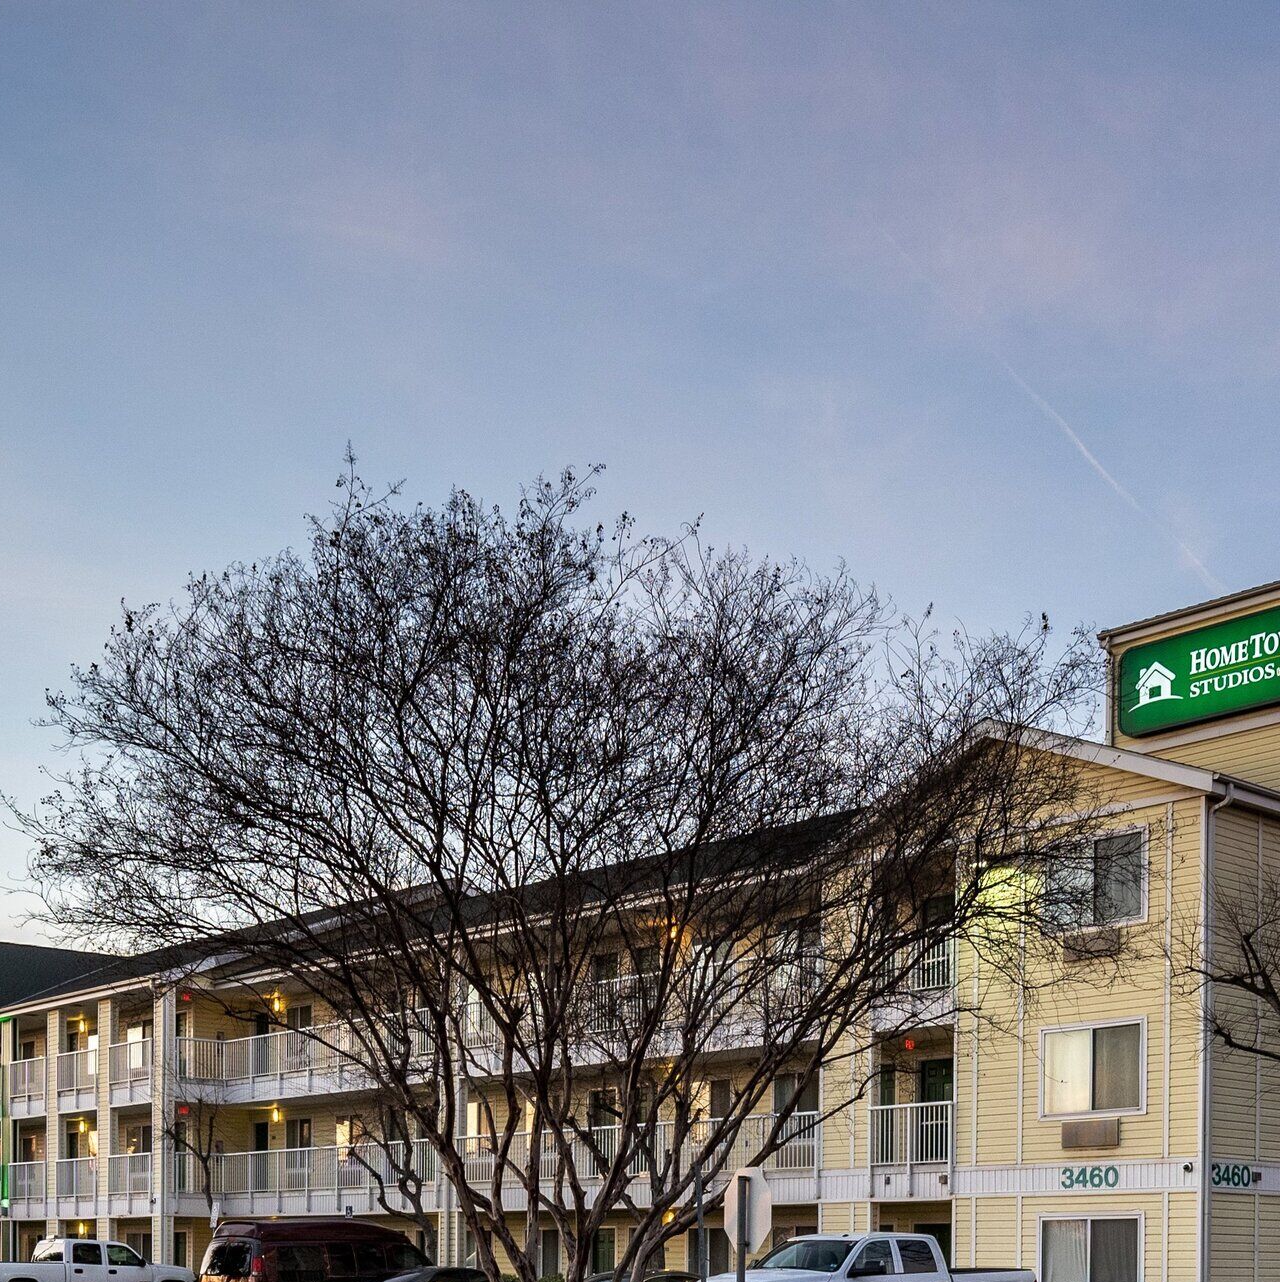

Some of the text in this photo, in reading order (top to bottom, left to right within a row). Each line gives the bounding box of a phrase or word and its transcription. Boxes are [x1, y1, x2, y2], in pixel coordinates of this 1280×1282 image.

[1189, 662, 1276, 698] STUDIOS
[1061, 1165, 1119, 1189] 3460
[1211, 1164, 1251, 1188] 3460
